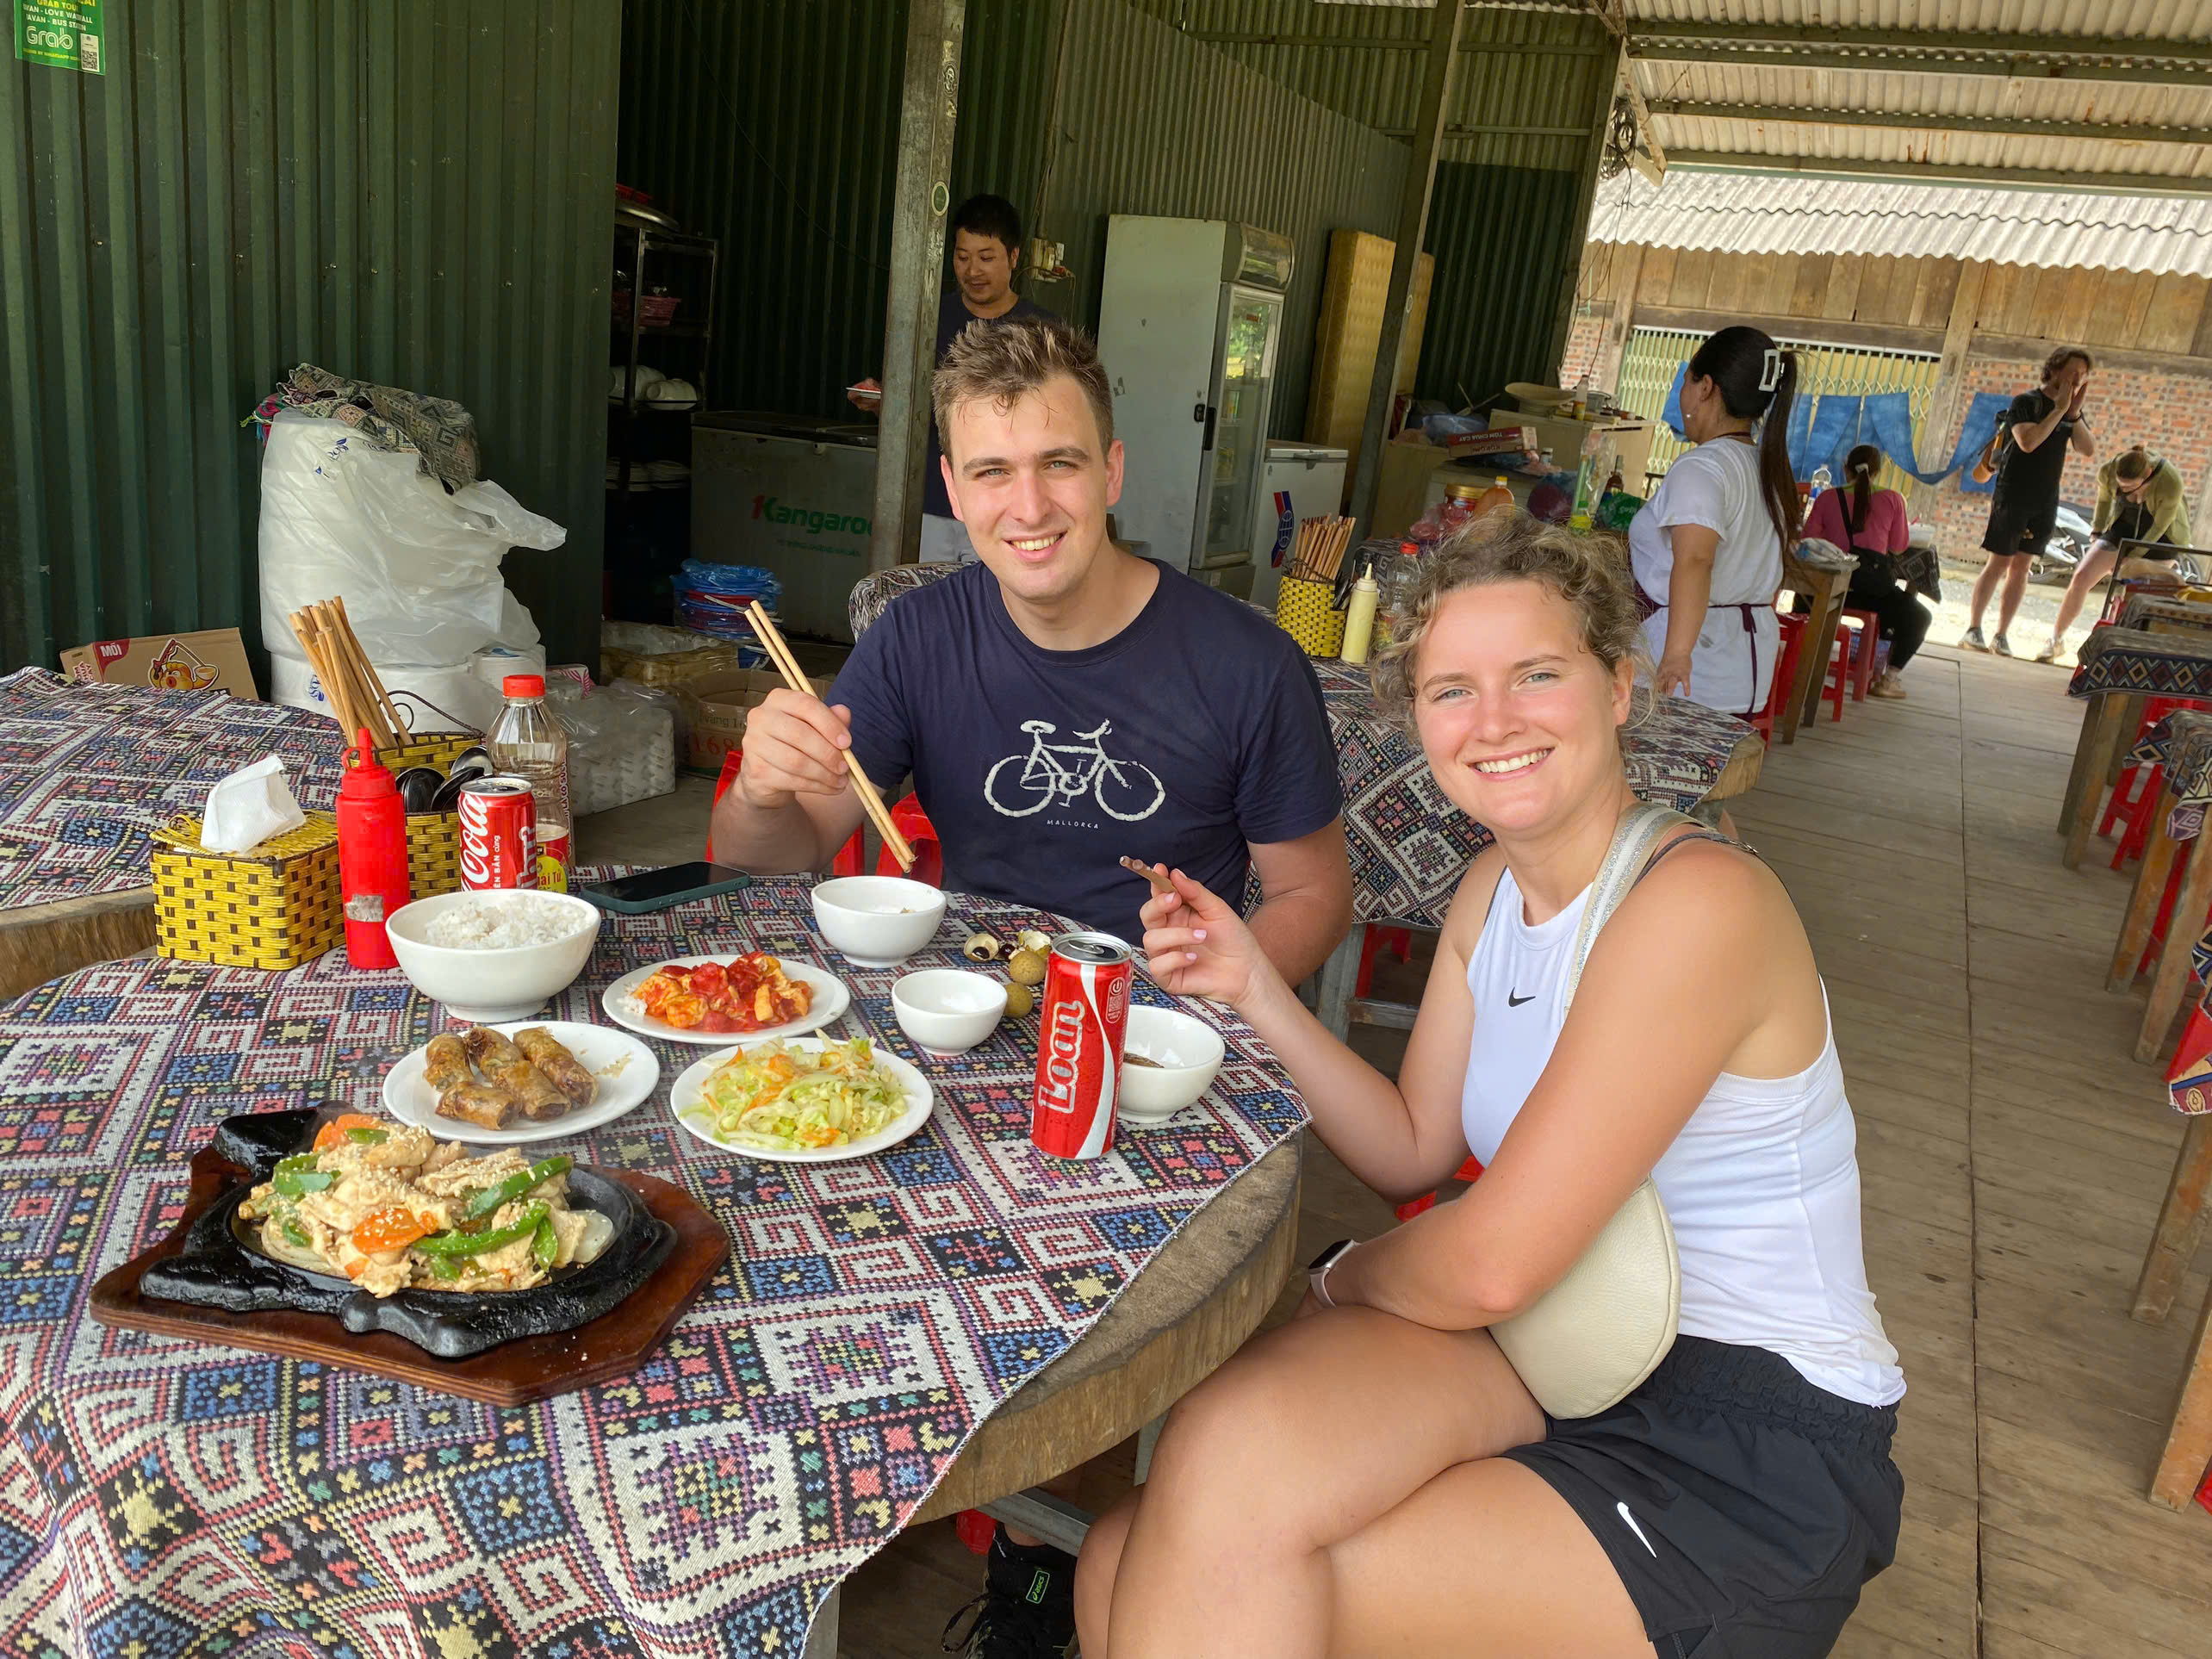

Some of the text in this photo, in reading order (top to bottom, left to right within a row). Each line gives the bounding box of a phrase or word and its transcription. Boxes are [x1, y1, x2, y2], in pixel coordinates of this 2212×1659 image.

[62, 2, 78, 11] TOU
[52, 18, 67, 27] BUS
[65, 12, 93, 24] WAALL
[27, 26, 73, 50] Grab
[751, 494, 873, 535] Kangaro
[1047, 819, 1098, 830] MALLORCA
[457, 792, 489, 884] Cola
[493, 835, 501, 853] cùng
[1038, 1000, 1085, 1114] Loan
